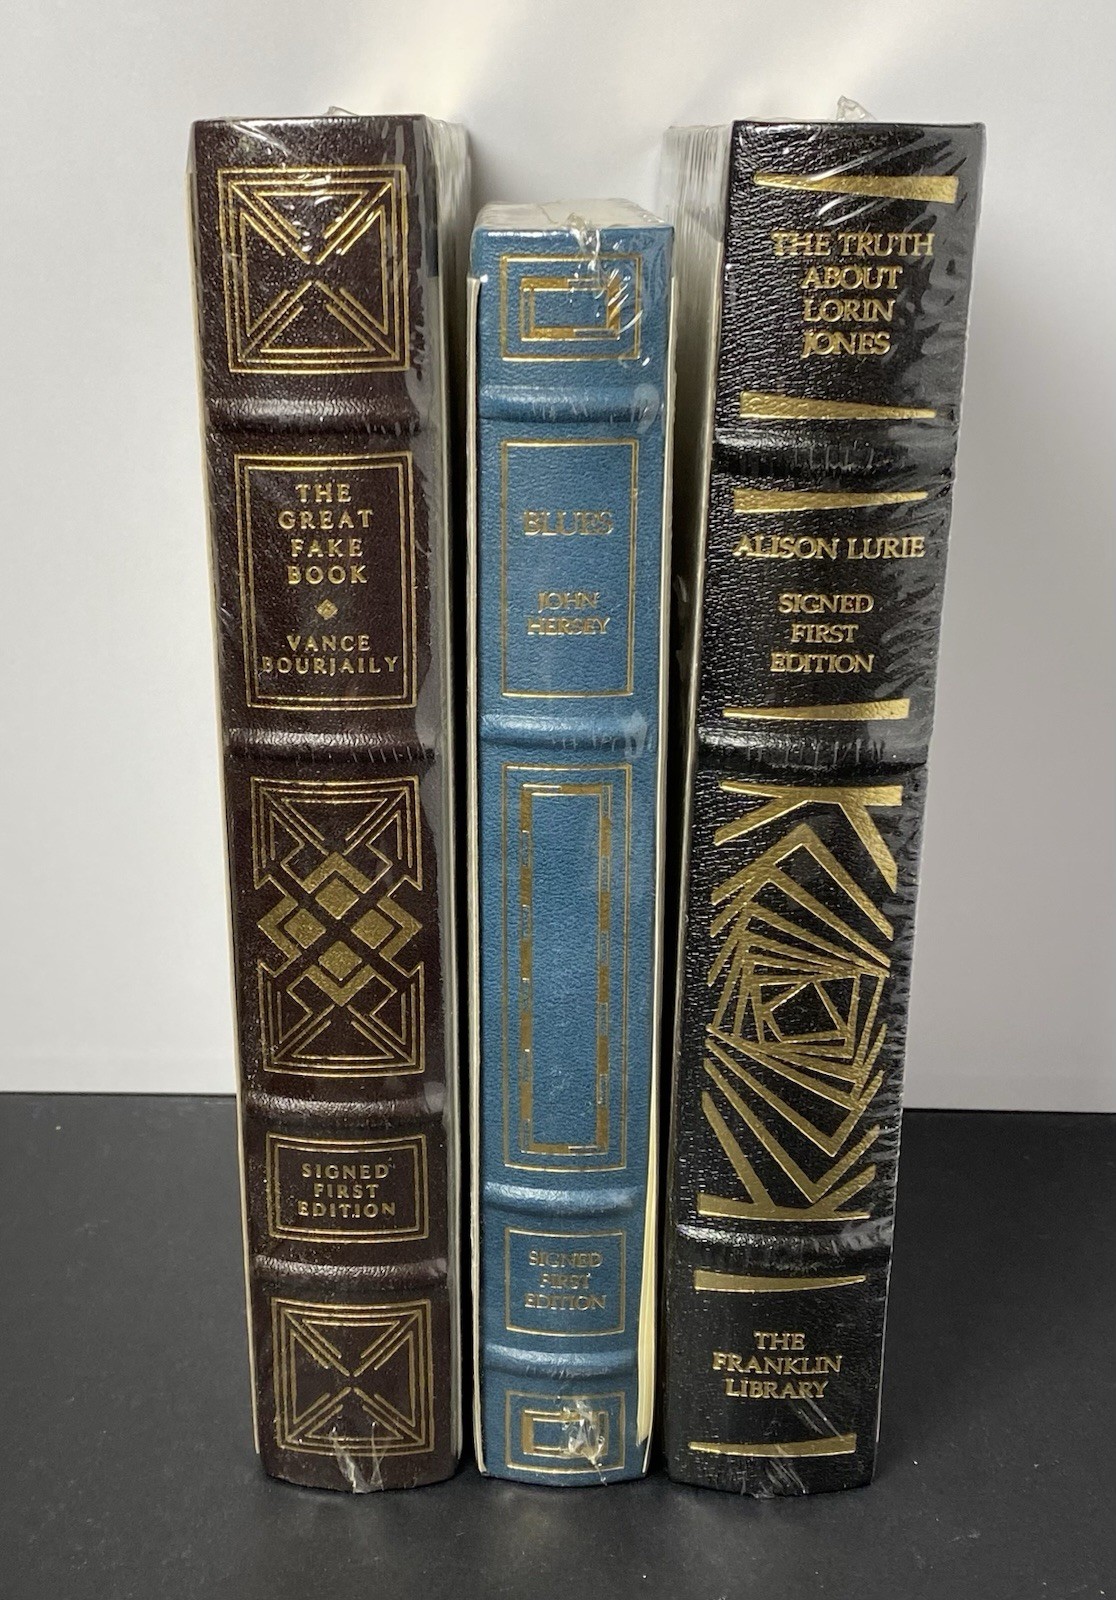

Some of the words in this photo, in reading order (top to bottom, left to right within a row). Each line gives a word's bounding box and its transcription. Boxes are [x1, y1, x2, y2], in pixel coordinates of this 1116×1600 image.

[771, 231, 831, 256] THE
[837, 232, 935, 257] TRUTH
[801, 265, 903, 290] ABOUT
[803, 298, 896, 323] LORIN
[801, 329, 891, 358] JONES
[295, 483, 352, 503] THE
[277, 509, 373, 530] GREAT
[522, 510, 615, 536] BLUES
[290, 538, 364, 558] FAKE
[732, 534, 840, 560] ALISON
[847, 536, 926, 559] LURIE
[286, 565, 368, 585] BOOK
[537, 590, 601, 614] JOHN
[777, 592, 874, 615] SIGNED
[526, 616, 611, 636] HERSEY
[790, 623, 859, 644] FIRST
[286, 634, 371, 652] VANCE
[262, 656, 399, 677] BOURJAILY
[769, 652, 875, 674] EDITION
[301, 1162, 390, 1180] SIGNED
[314, 1182, 379, 1199] FIRST
[297, 1200, 396, 1219] EDITION
[528, 1249, 604, 1268] SIGNED
[540, 1272, 591, 1290] FIRST
[524, 1292, 607, 1311] EDITION
[753, 1330, 806, 1351] THE
[711, 1350, 843, 1375] FRANKLIN
[724, 1376, 829, 1400] LIBRARY
